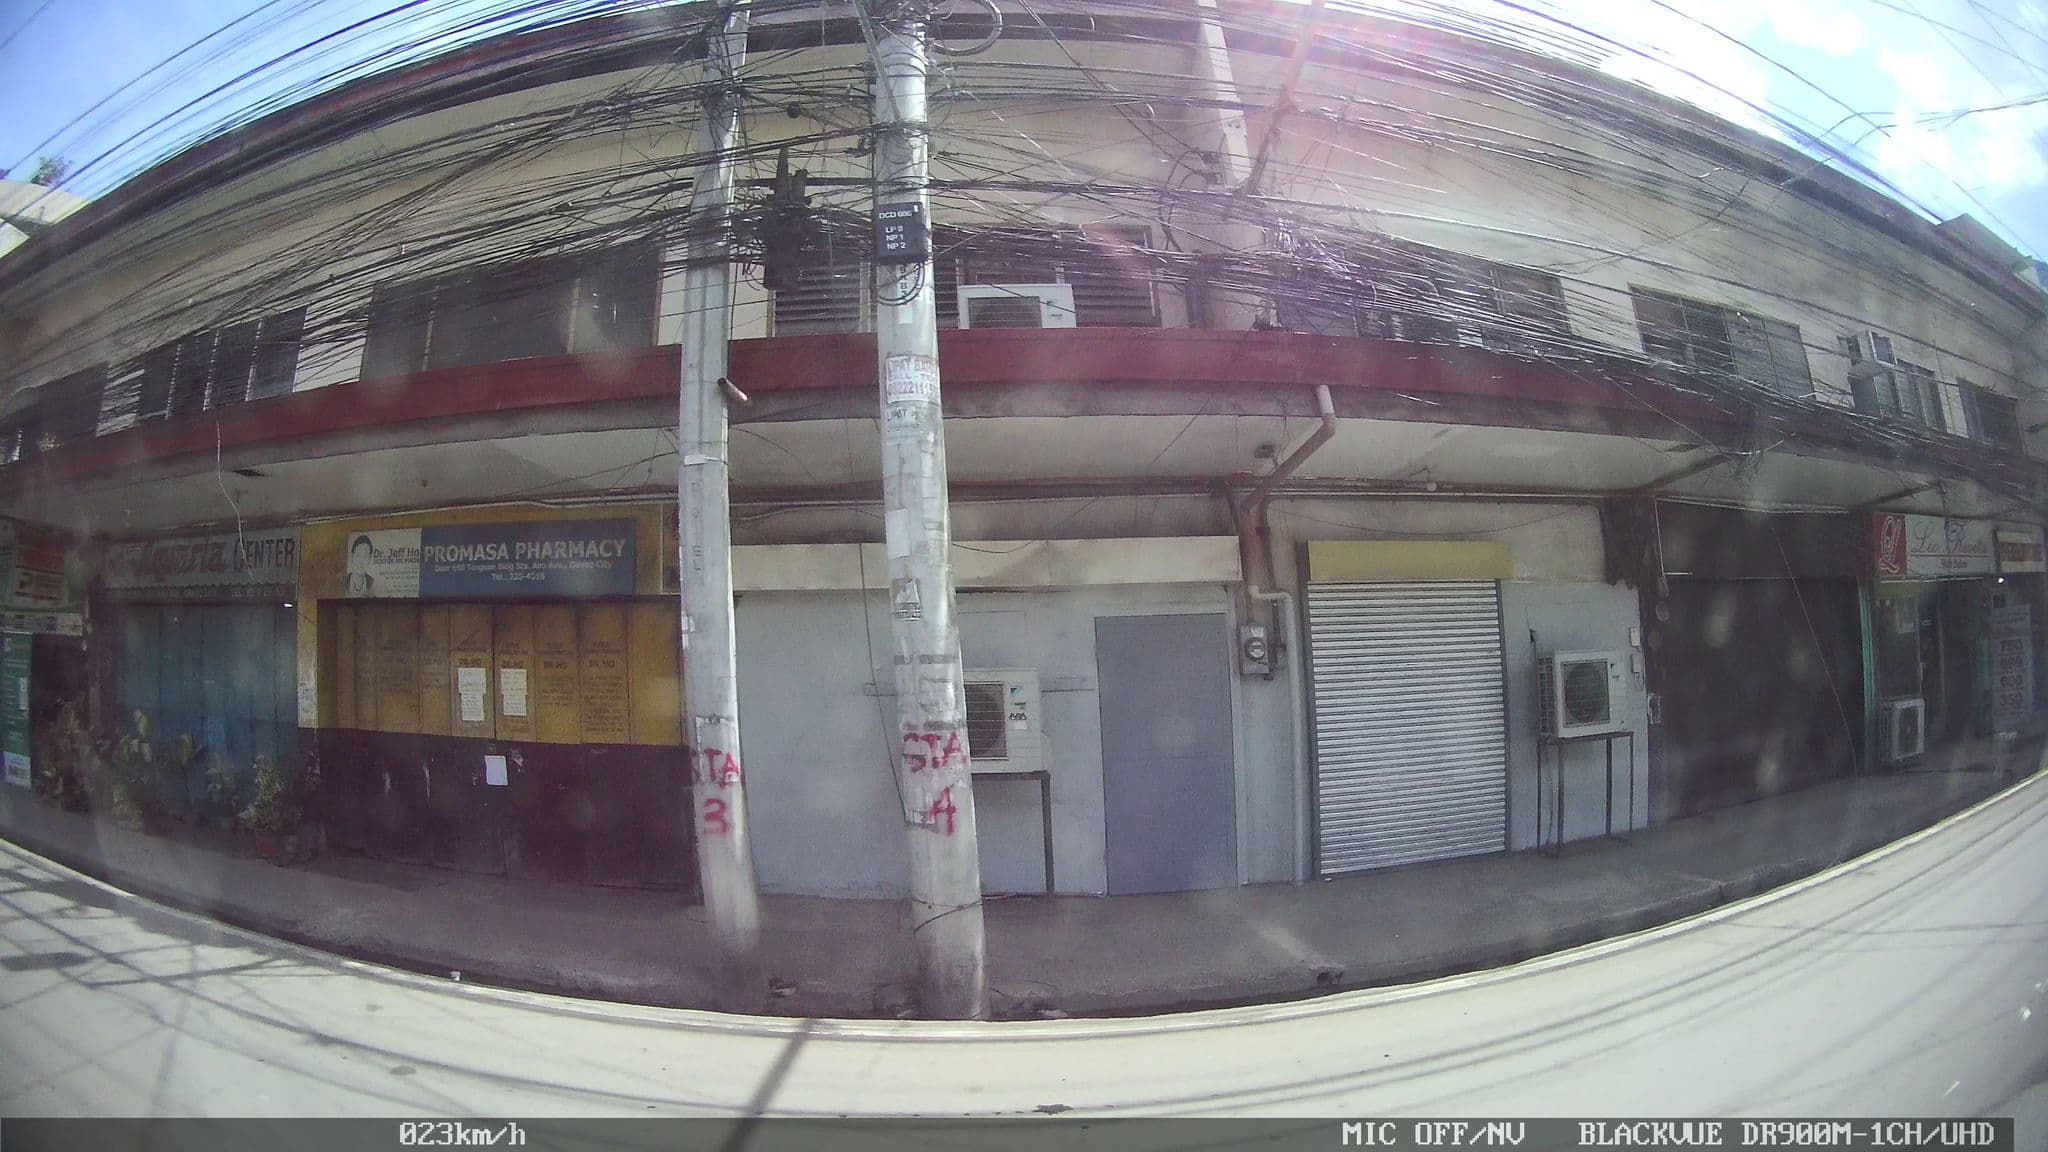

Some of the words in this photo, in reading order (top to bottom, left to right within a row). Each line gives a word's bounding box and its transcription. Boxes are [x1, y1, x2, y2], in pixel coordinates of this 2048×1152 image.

[234, 537, 296, 572] CENTER
[387, 547, 405, 558] Jeff
[407, 547, 419, 557] Ho
[424, 542, 509, 562] PROMASA
[515, 538, 627, 560] PHARMACY
[901, 729, 967, 772] STA
[703, 797, 729, 835] 3
[928, 786, 957, 836] 4
